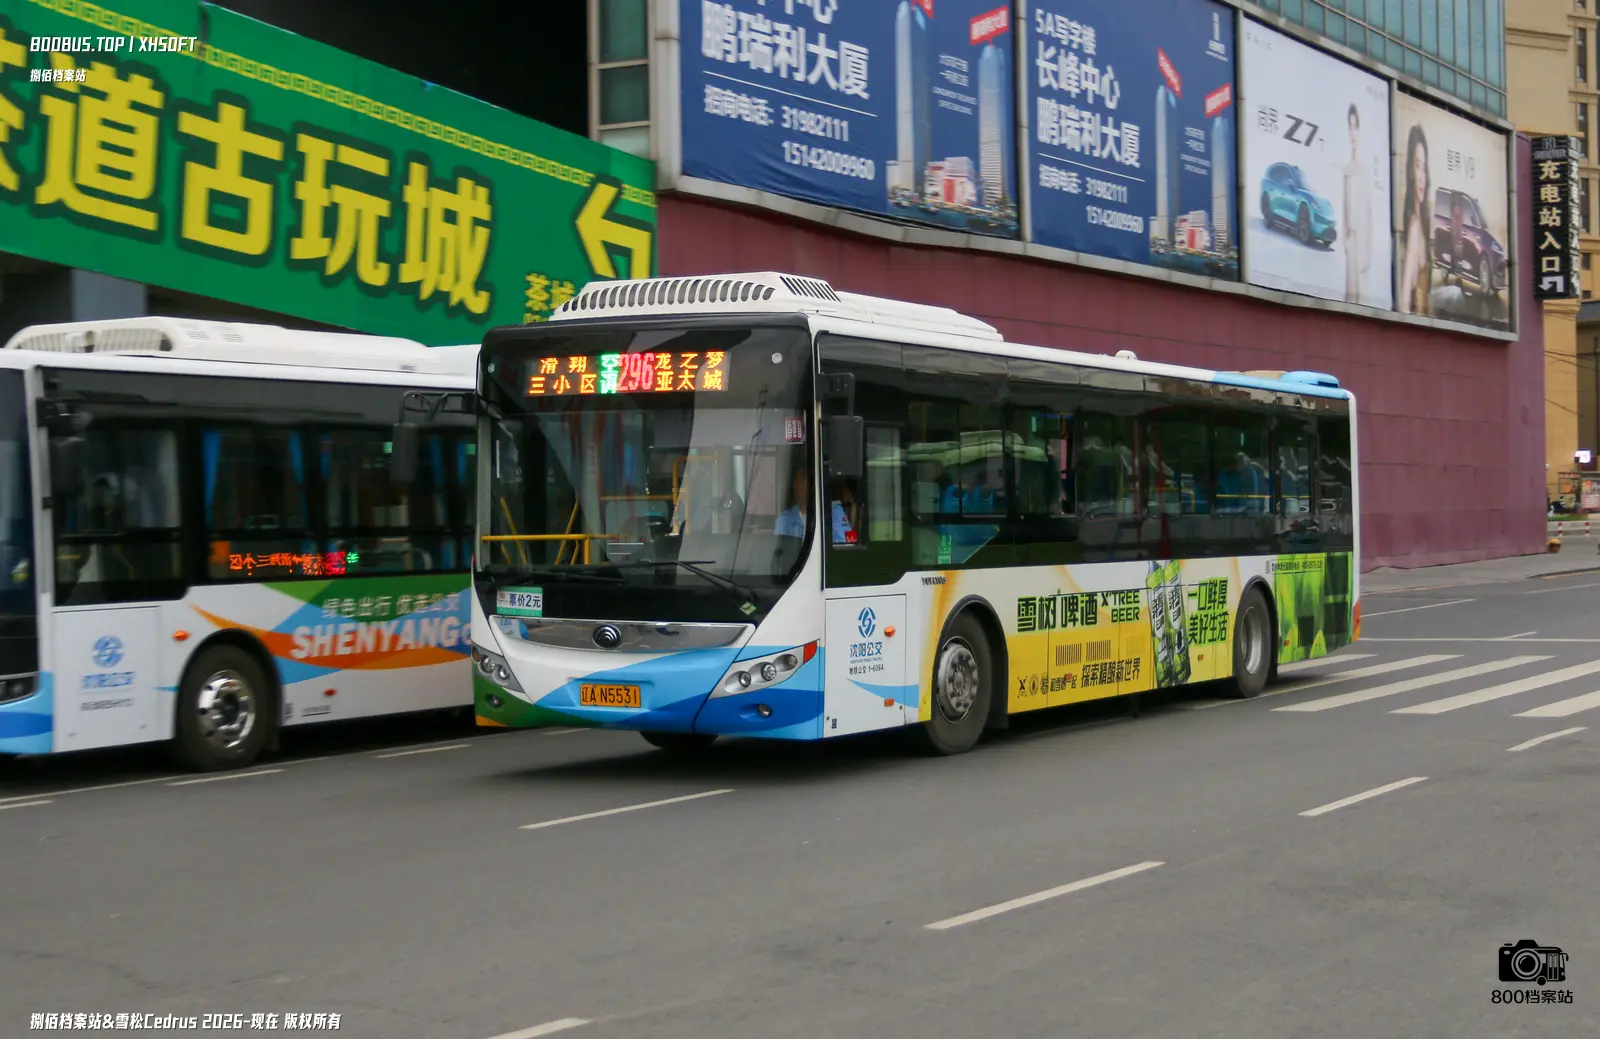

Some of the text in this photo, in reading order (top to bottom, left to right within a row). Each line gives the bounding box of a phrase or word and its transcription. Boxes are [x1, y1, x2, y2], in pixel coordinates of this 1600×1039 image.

[701, 1, 870, 99] 鹏瑞利大厦
[1036, 40, 1121, 110] 长峰中心
[1037, 96, 1141, 168] 鹏瑞利大厦
[0, 27, 492, 315] 道古玩城
[1539, 160, 1562, 273] 充电站入口
[539, 355, 589, 375] 滑翔
[616, 352, 655, 391] 296
[654, 351, 726, 371] 龙之梦
[529, 373, 598, 395] 三小区
[654, 370, 723, 392] 亚太城
[509, 593, 542, 608] 票价2元
[1017, 590, 1099, 632] 雪树啤酒
[1111, 606, 1141, 623] BEER
[290, 615, 461, 660] SHENYANG
[1187, 611, 1229, 645] 美好生活
[850, 641, 883, 658] 沈阳公交
